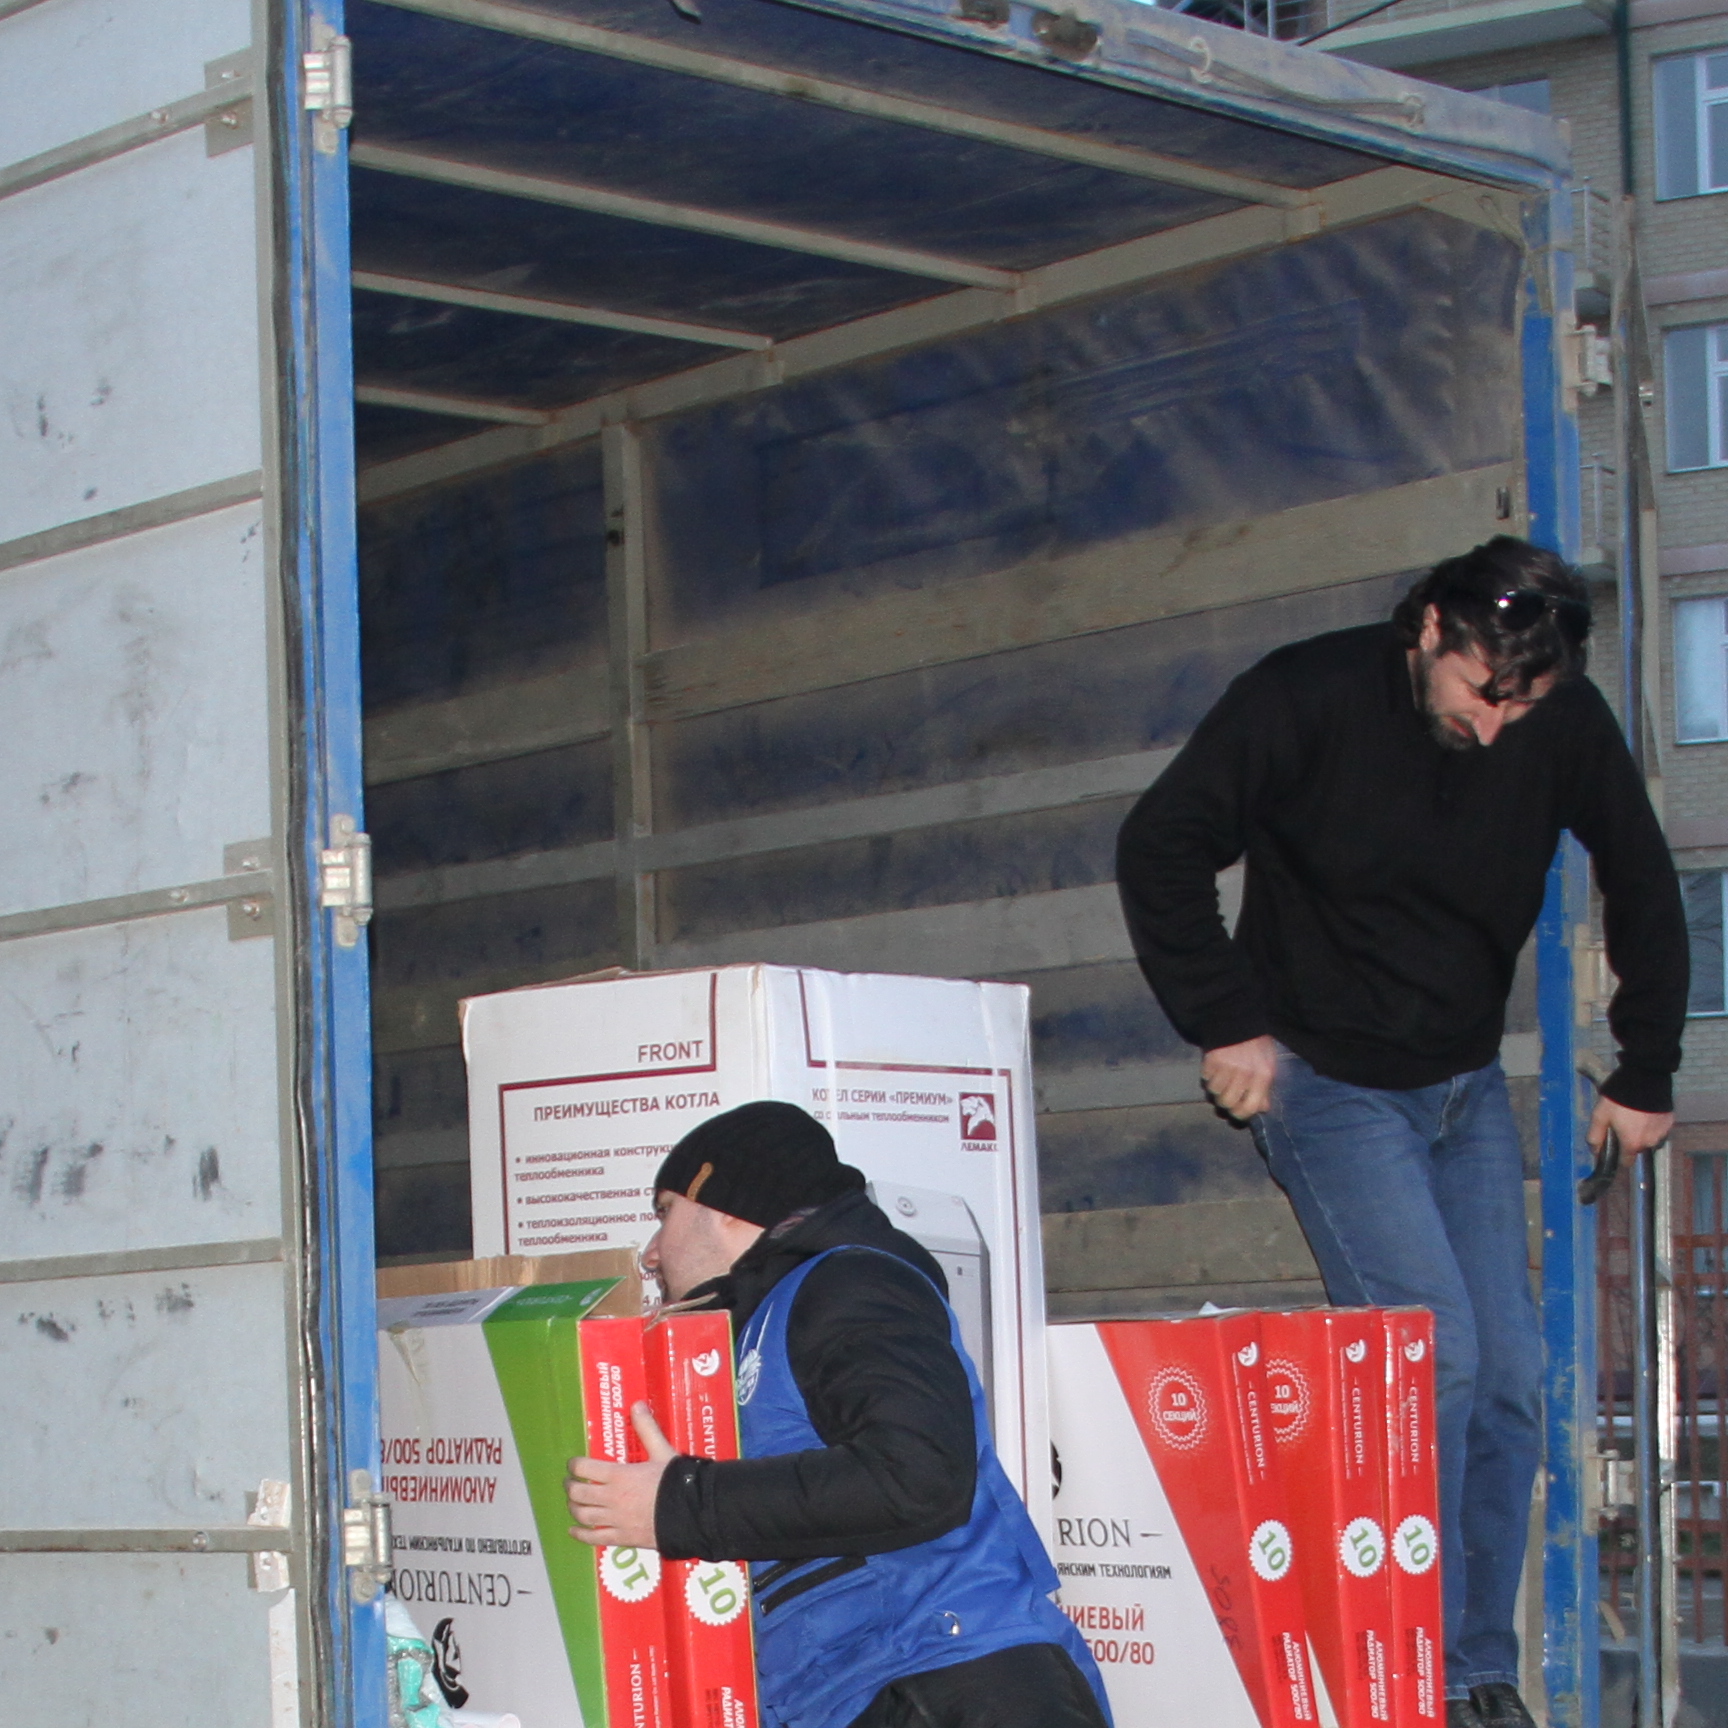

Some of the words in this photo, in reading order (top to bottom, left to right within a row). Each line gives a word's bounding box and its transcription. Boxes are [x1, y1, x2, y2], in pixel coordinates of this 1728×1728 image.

[637, 1039, 704, 1063] FRONT
[534, 1095, 660, 1122] ПРЕИМУЩЕСТВА
[665, 1091, 720, 1110] КОТЛА
[851, 1090, 886, 1104] СЕРИИ
[889, 1091, 954, 1106] «ПРЕМИУМ»
[525, 1149, 610, 1164] инновационная
[515, 1166, 604, 1182] теплообменника
[526, 1187, 640, 1205] высококачественная
[527, 1212, 636, 1230] теплоизоляционное
[518, 1231, 608, 1247] теплообменника
[1172, 1392, 1186, 1407] 10
[1275, 1384, 1290, 1399] 10
[596, 1361, 615, 1457] АЛЮМИНИЕВЫЙ
[1247, 1391, 1265, 1468] CENTURION
[1352, 1387, 1364, 1464] CENTURION
[1409, 1386, 1420, 1463] CENTURION
[426, 1437, 502, 1464] РАДИАТОР
[409, 1535, 463, 1552] ИТАЛЬЯНСКИМ
[465, 1537, 476, 1553] ПО
[477, 1538, 532, 1555] ИЗГОТОВЛЕНО
[1258, 1530, 1286, 1571] 10
[1349, 1526, 1377, 1568] 10
[1403, 1525, 1430, 1565] 10
[1098, 1563, 1171, 1579] ТЕХНОЛОГИЯМ
[697, 1566, 737, 1615] 10
